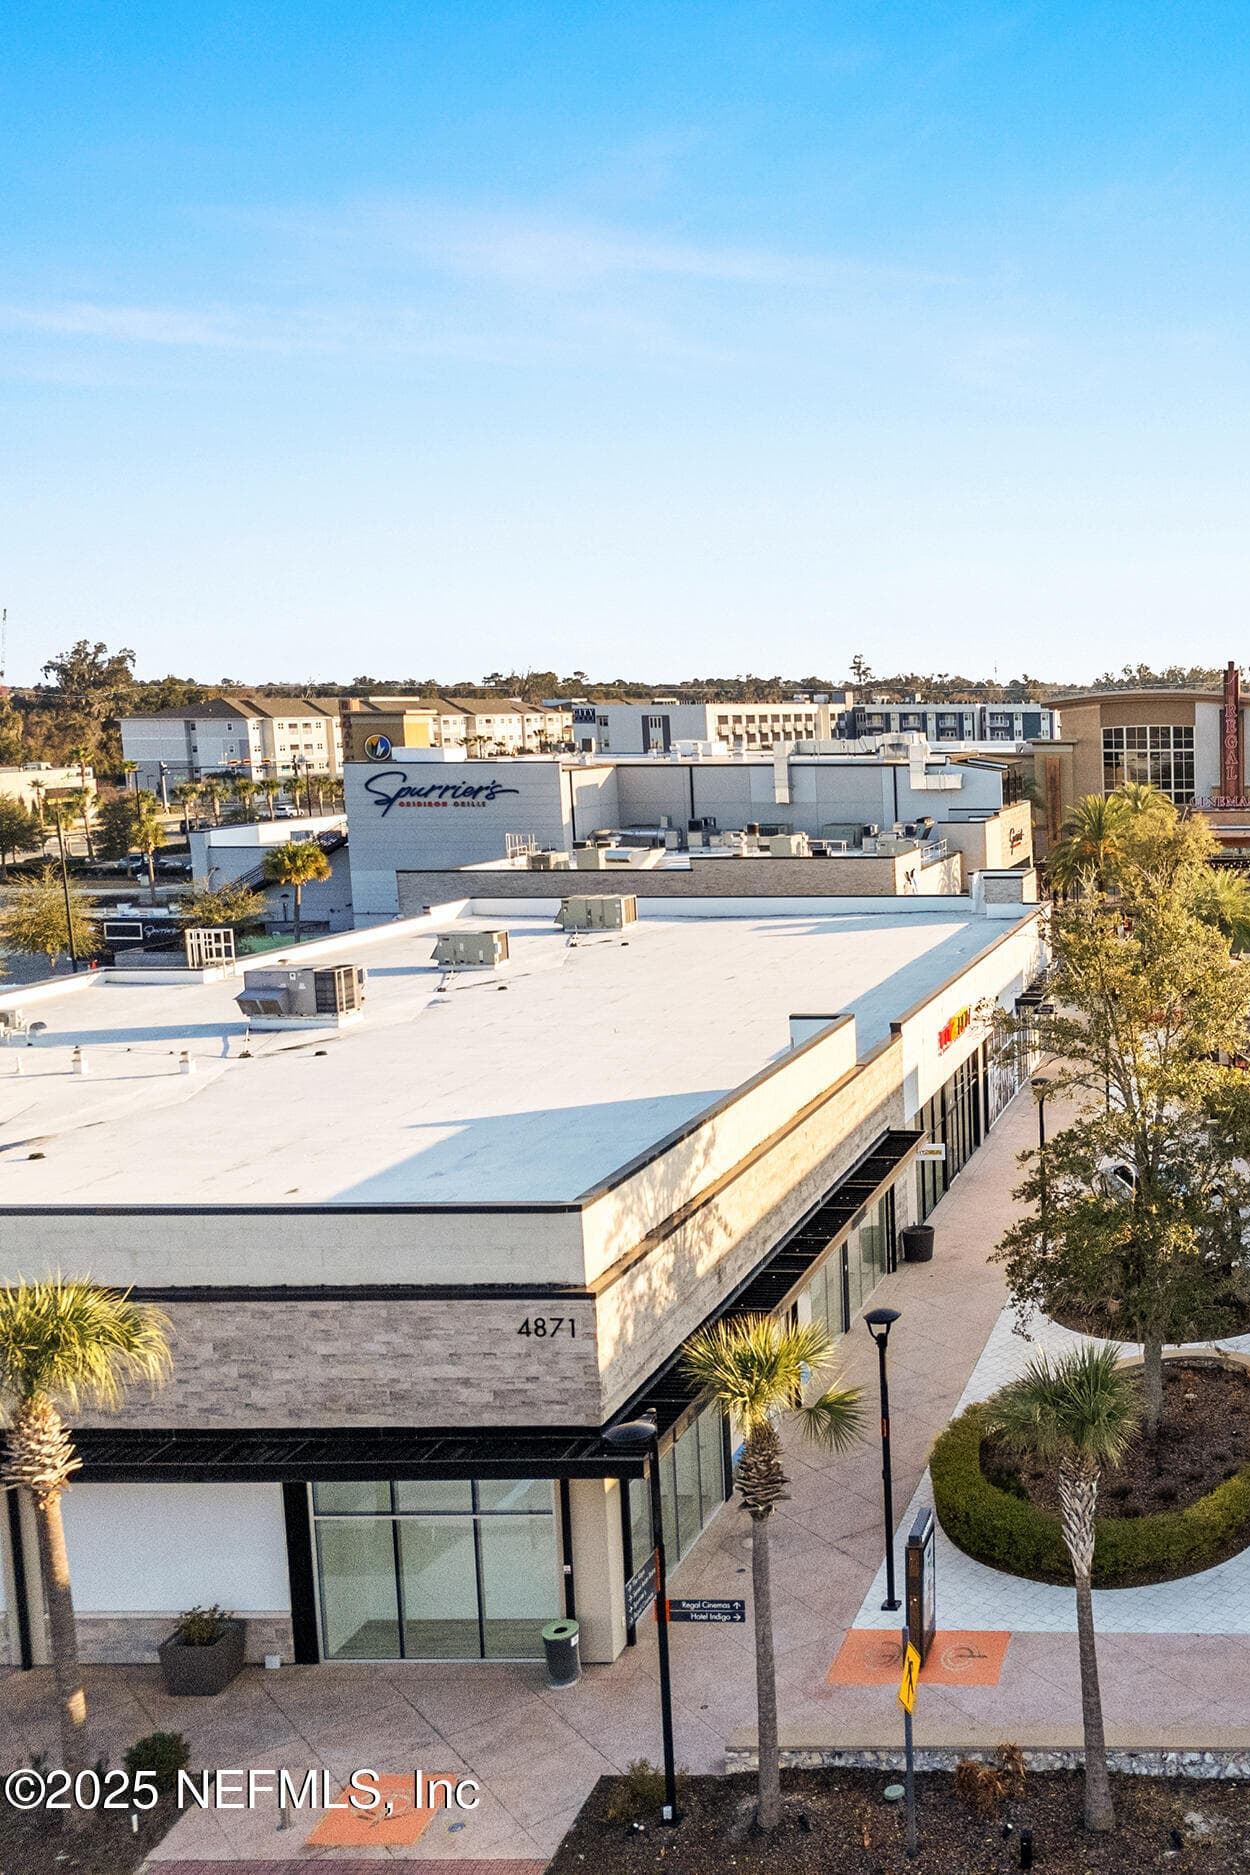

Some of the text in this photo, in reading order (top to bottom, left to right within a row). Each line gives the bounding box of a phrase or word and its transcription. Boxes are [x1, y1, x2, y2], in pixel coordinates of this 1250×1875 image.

[1225, 704, 1238, 780] REGAL
[364, 771, 520, 818] Spurrier's
[517, 1317, 576, 1339] 4871
[681, 1601, 731, 1610] Regal Cinemas
[690, 1612, 731, 1622] Hotel Indigo
